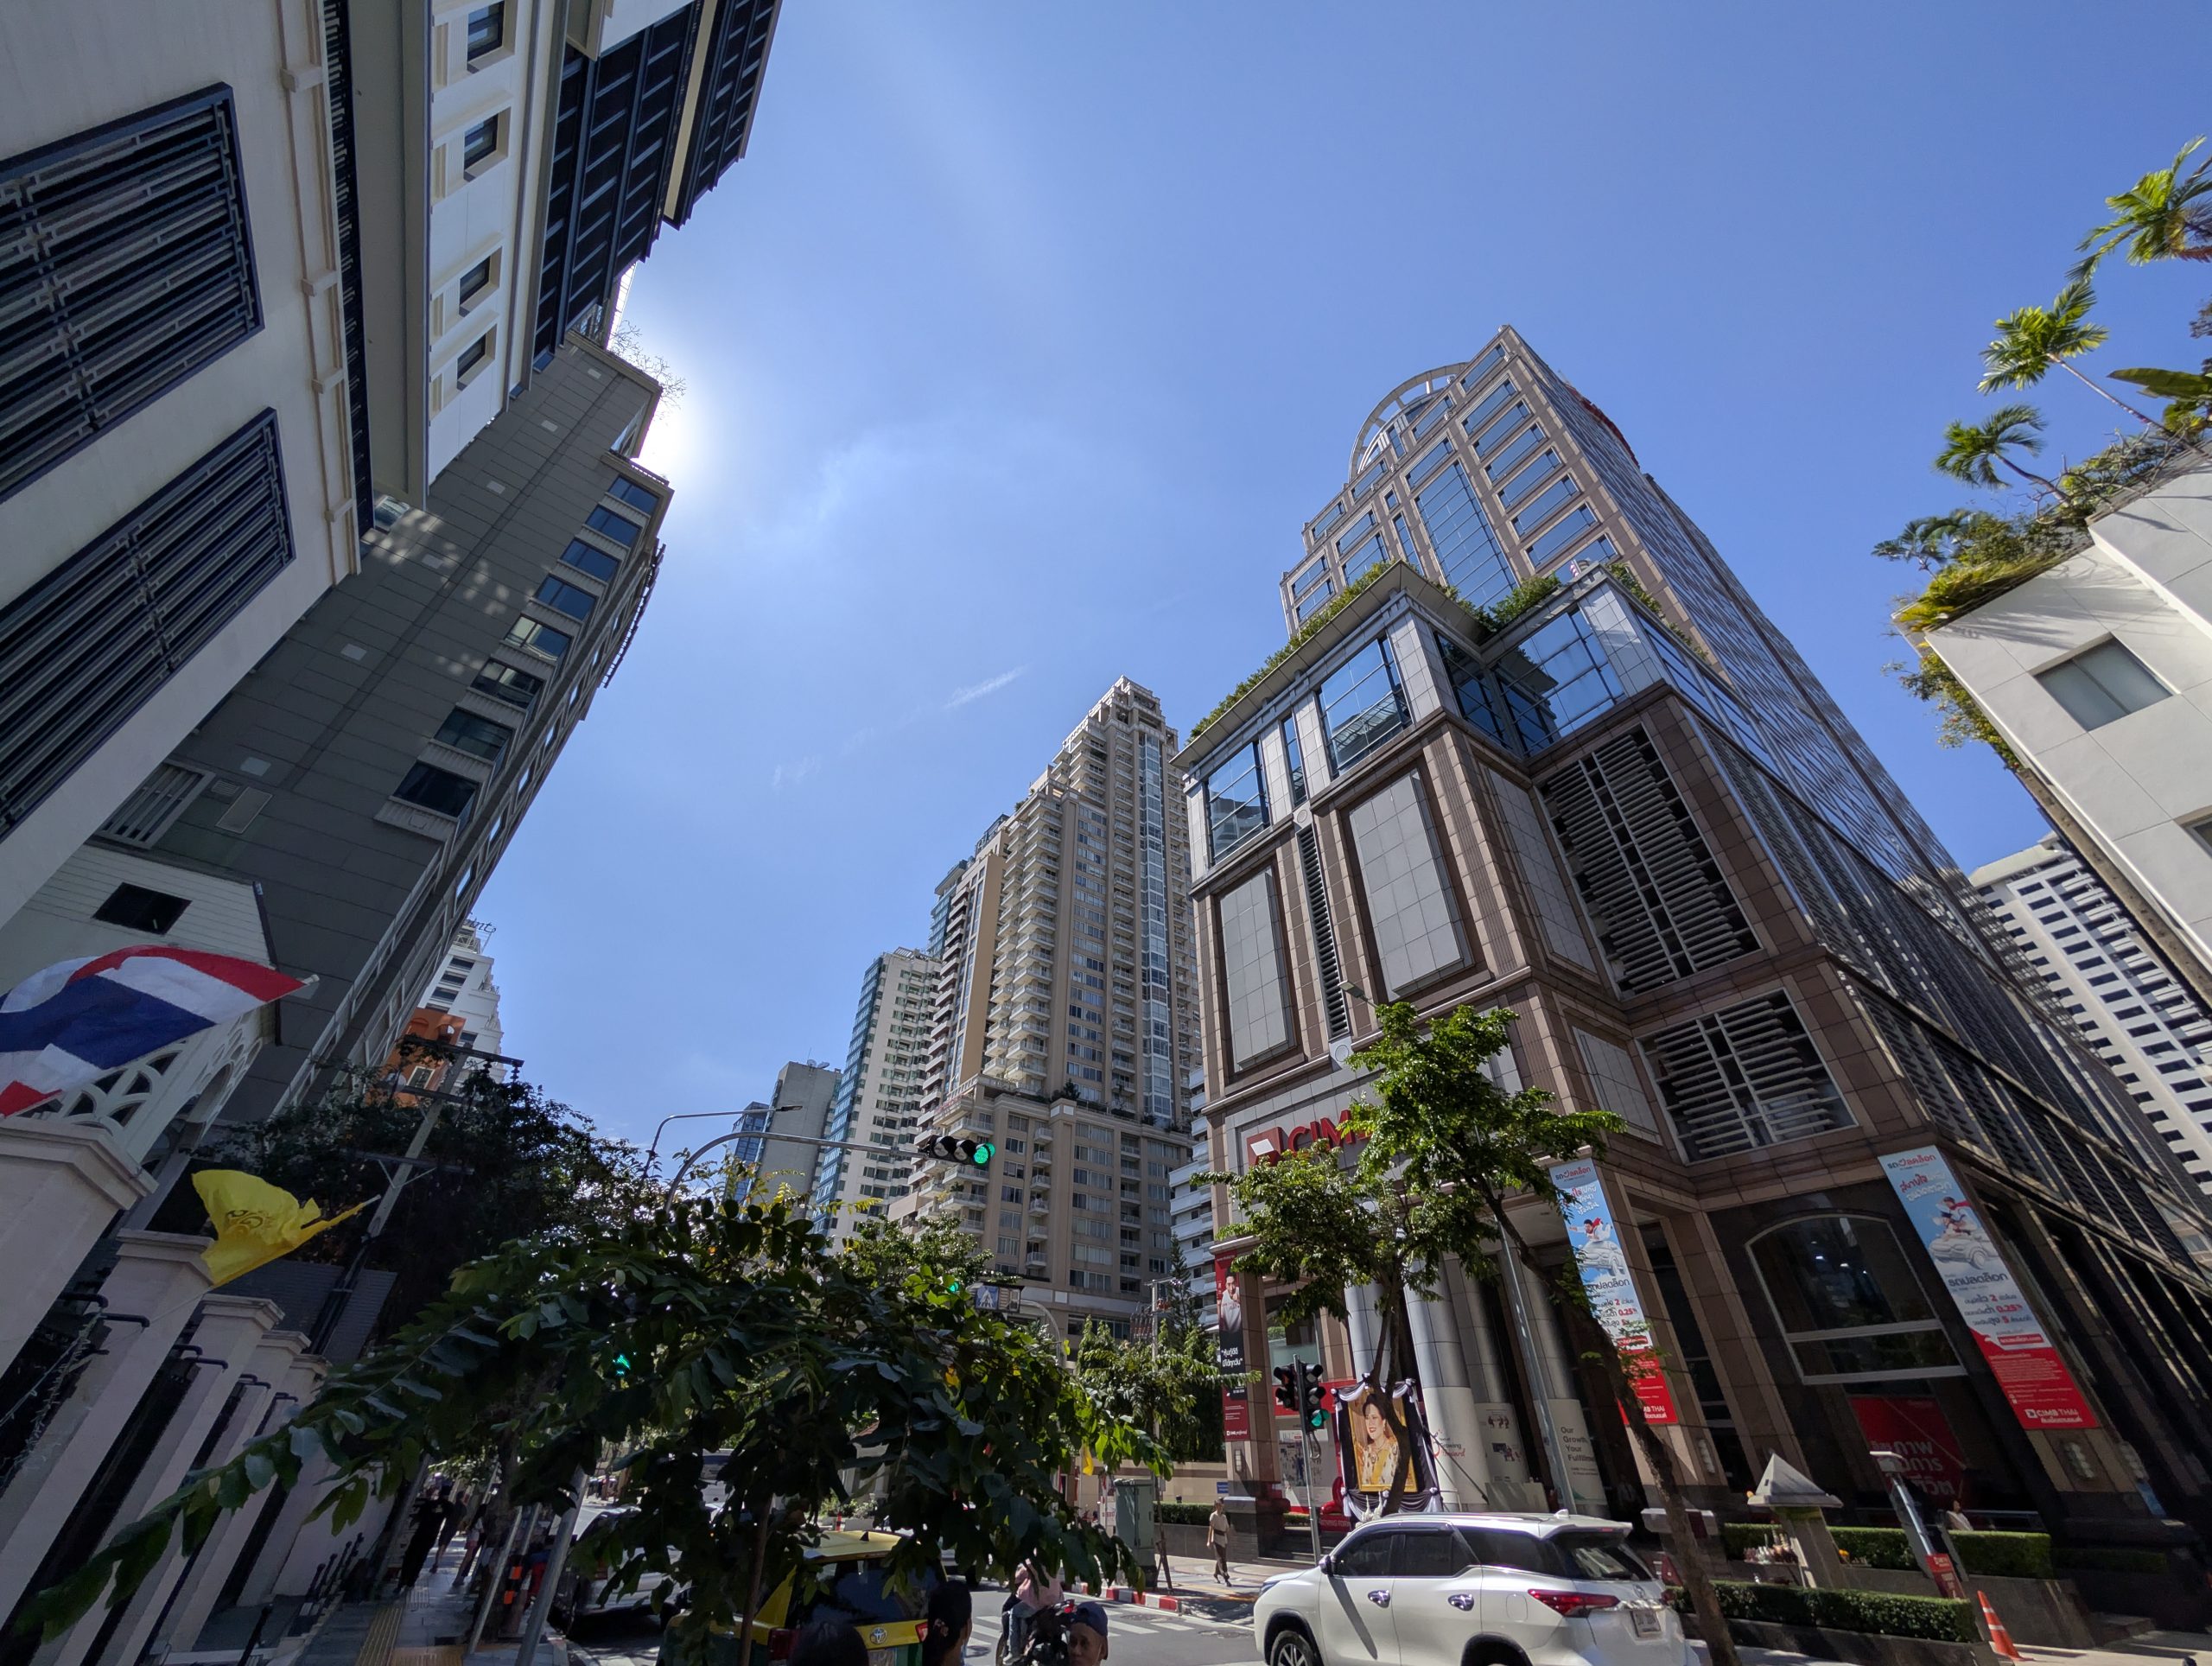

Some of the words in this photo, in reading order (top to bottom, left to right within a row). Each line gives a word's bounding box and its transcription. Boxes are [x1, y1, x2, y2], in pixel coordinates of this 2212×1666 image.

[1287, 1110, 1372, 1158] CIM
[1588, 1278, 1630, 1290] ถปลดล็อก
[1948, 1273, 2009, 1287] รถปลดล็อก
